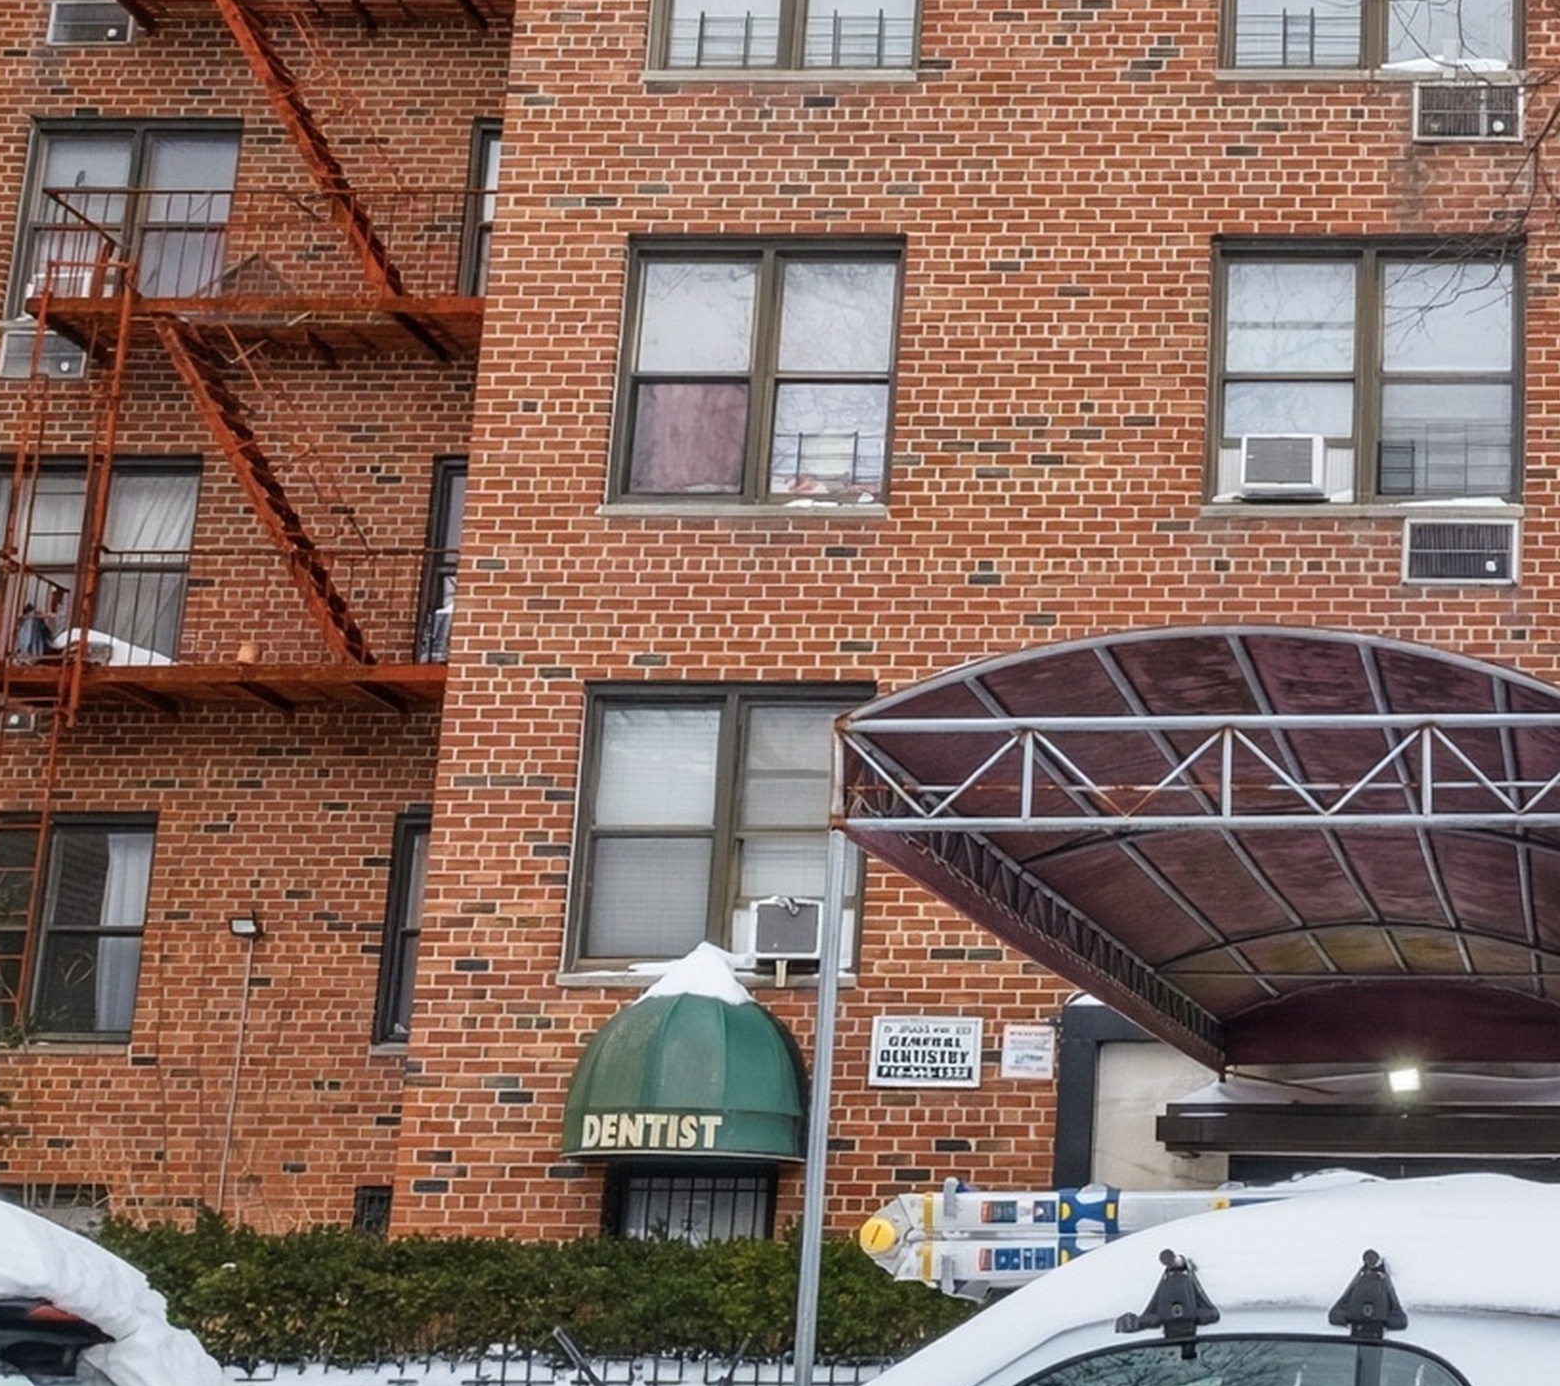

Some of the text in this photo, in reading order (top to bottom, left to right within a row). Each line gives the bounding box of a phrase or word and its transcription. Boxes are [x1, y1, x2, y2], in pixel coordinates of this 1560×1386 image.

[888, 1035, 962, 1049] GENERAL
[880, 1049, 970, 1064] DENTISTRY
[581, 1113, 723, 1149] DENTIST
